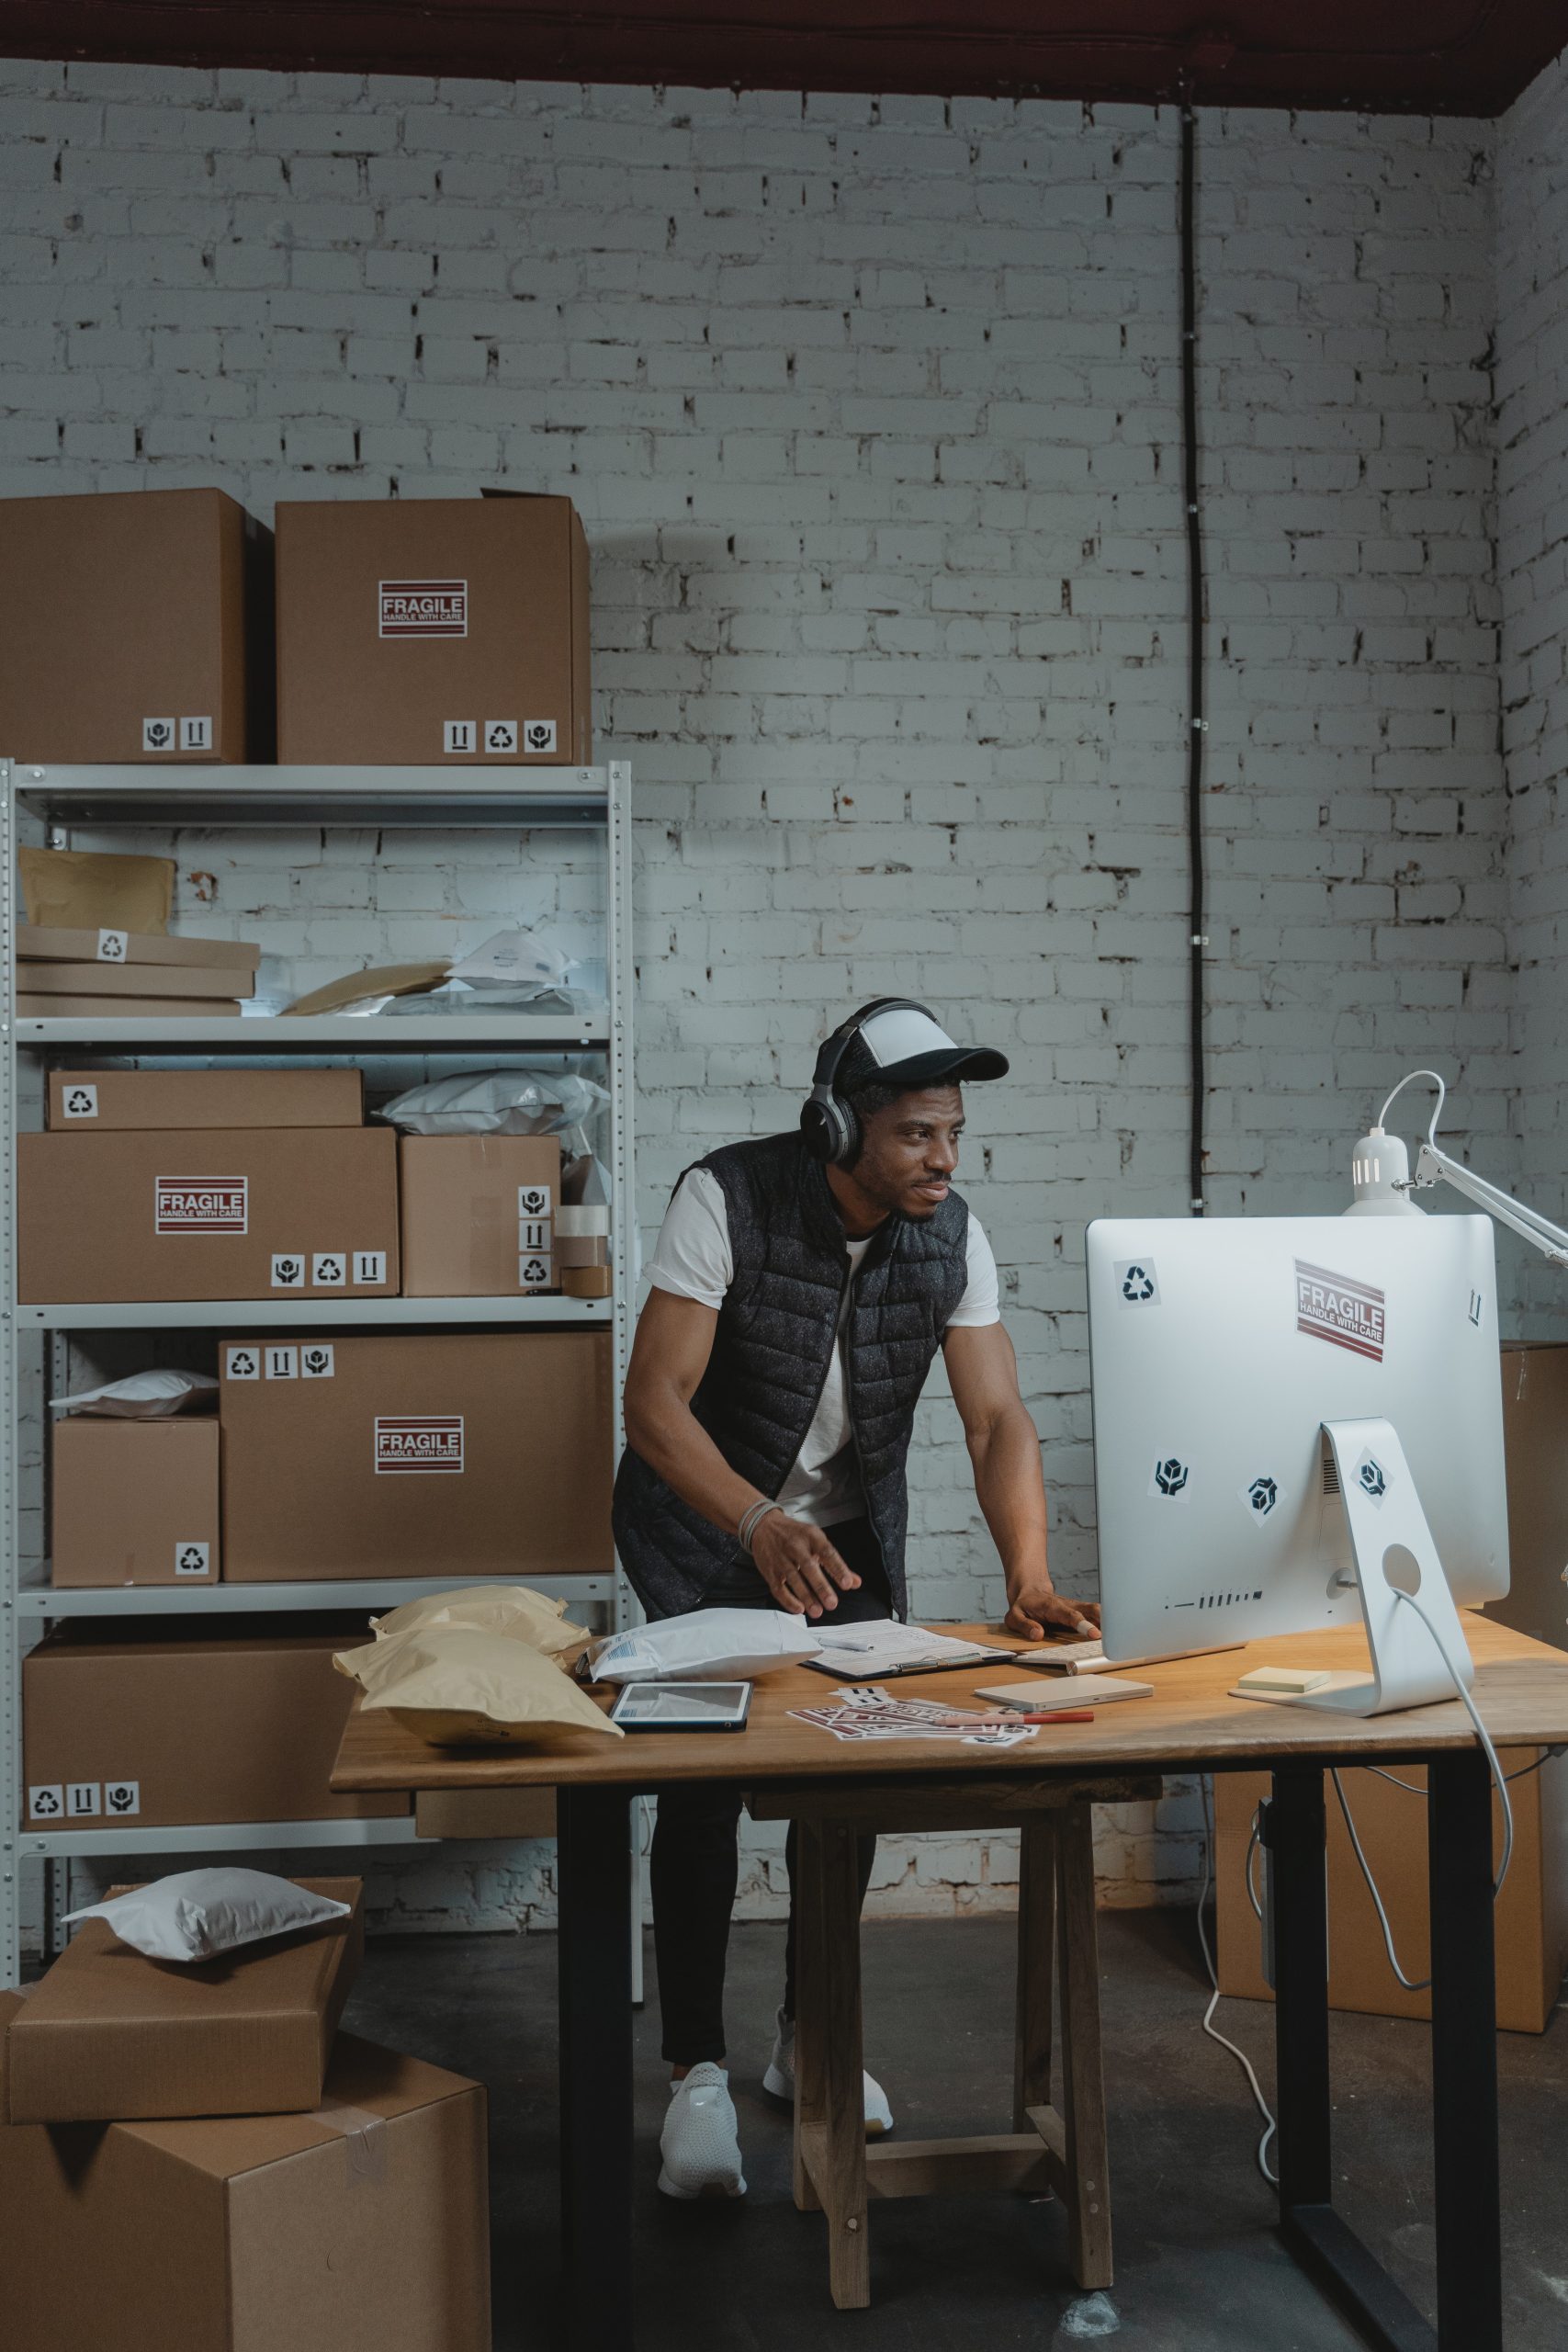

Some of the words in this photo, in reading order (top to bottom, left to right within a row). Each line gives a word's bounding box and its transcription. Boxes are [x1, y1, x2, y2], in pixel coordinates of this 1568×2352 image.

[383, 598, 463, 614] FRAGILE
[383, 613, 417, 621] HANDLE
[418, 613, 438, 621] WITH
[160, 1194, 243, 1210] FRAGILE
[1299, 1281, 1382, 1332] FRAGILE
[1300, 1301, 1336, 1323] HANDLE
[1337, 1315, 1358, 1332] WITH
[1359, 1325, 1382, 1341] CARE
[378, 1434, 459, 1450] FRAGILE
[379, 1449, 413, 1457] HANDLE
